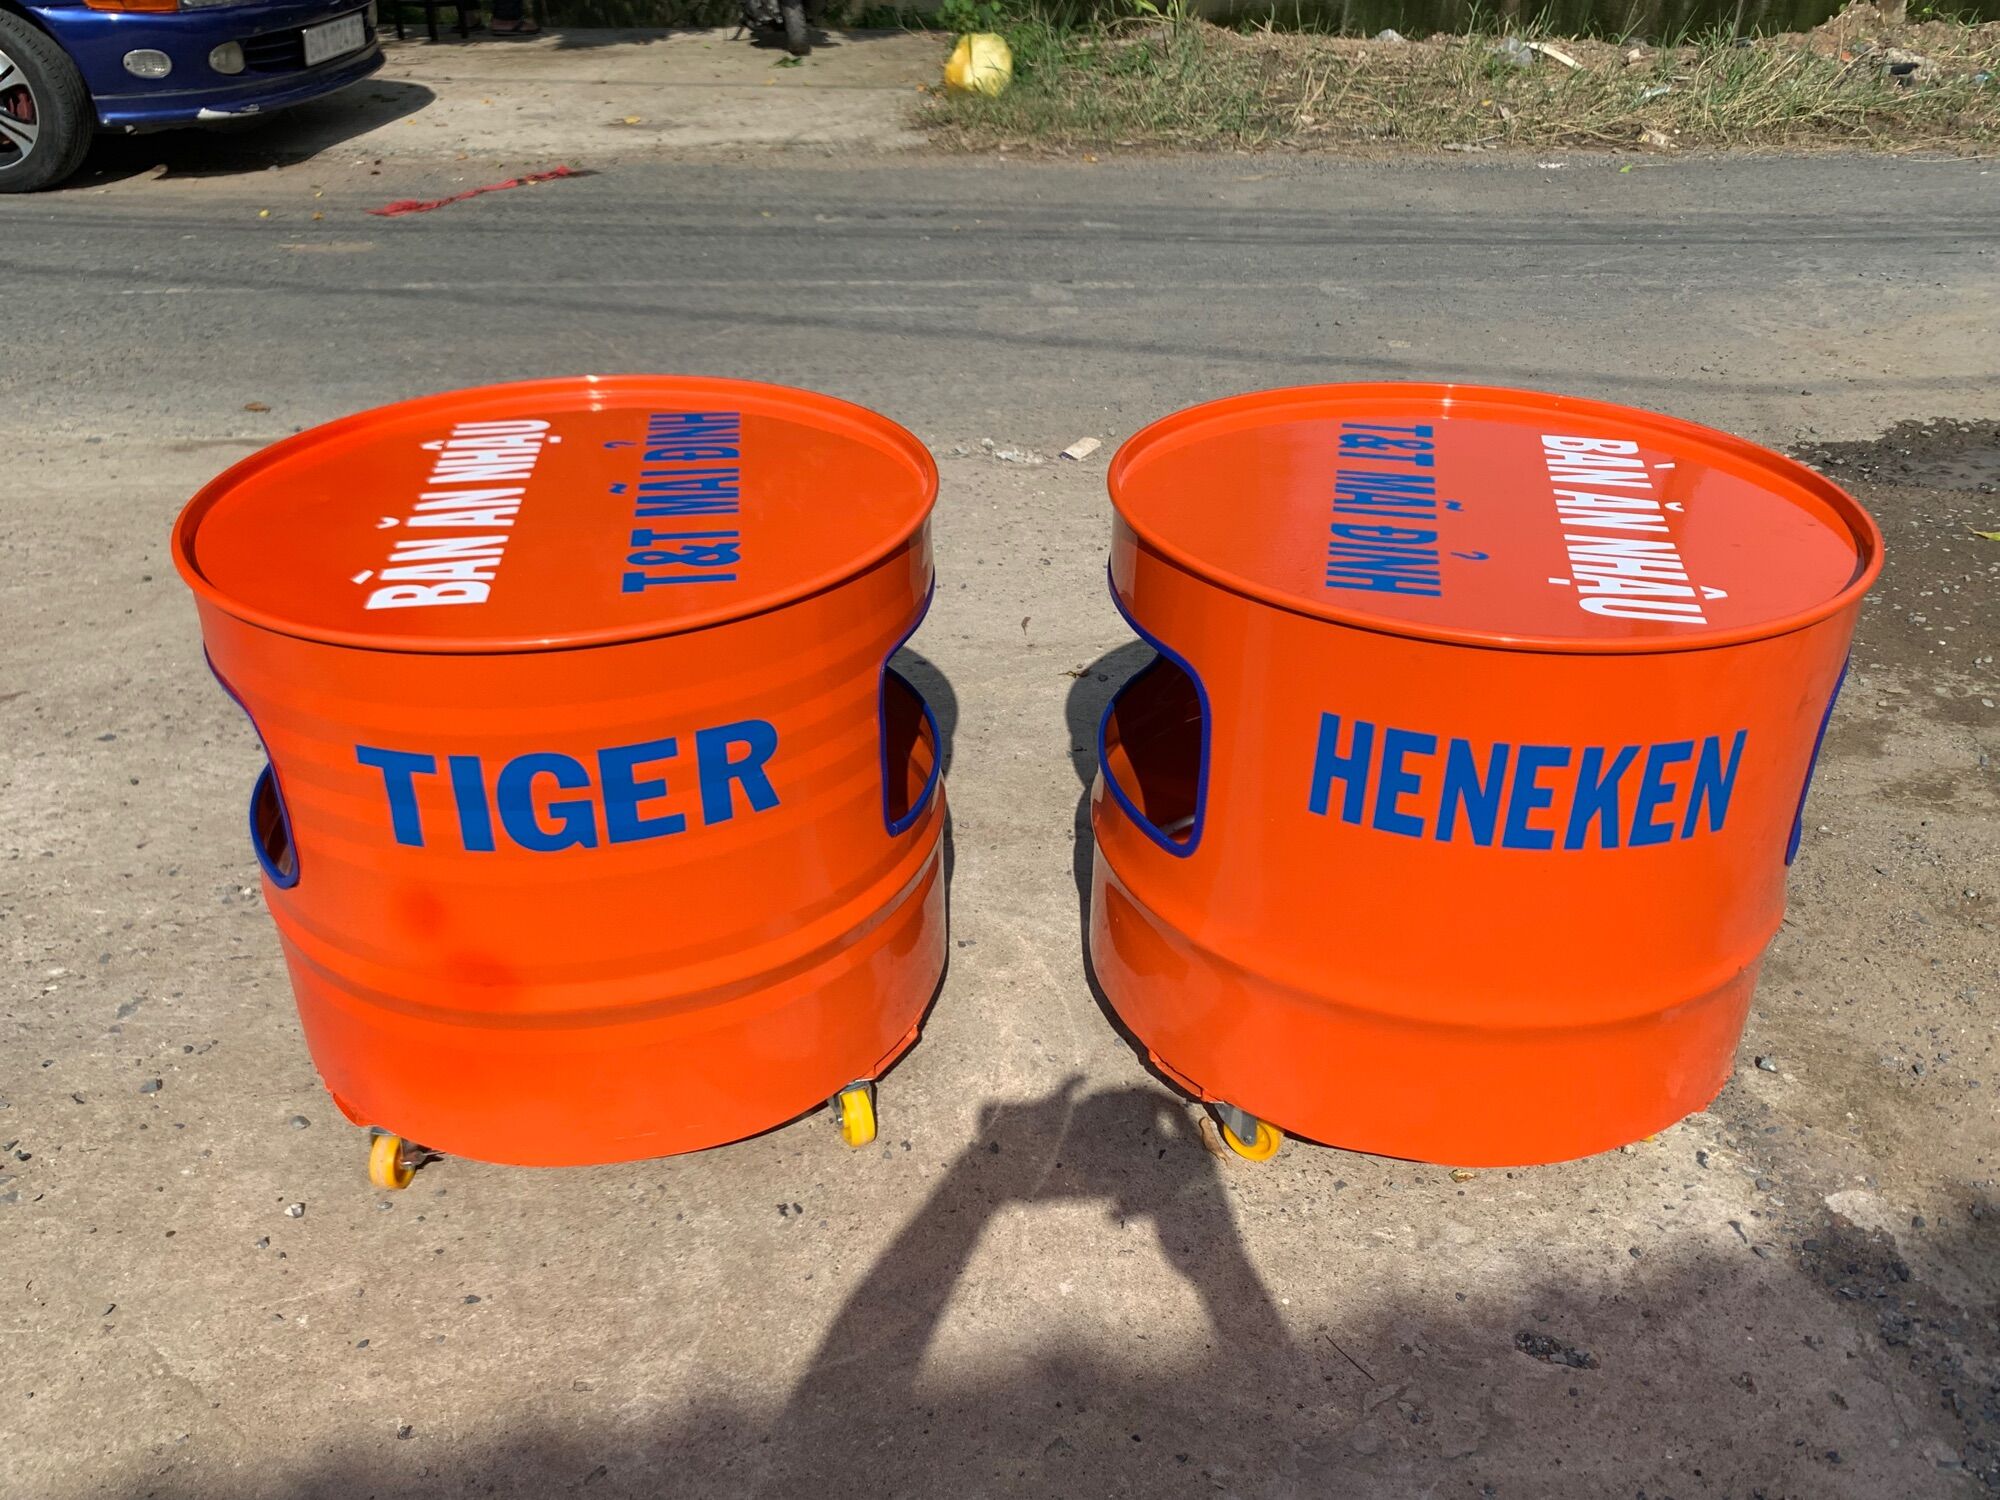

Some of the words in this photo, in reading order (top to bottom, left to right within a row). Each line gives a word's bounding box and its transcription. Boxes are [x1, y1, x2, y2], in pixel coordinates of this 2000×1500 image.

[419, 419, 561, 486] NHẬU
[603, 412, 740, 462] ĐỈNH
[1339, 422, 1436, 467] T&T
[1541, 434, 1676, 488] BÀN
[375, 487, 526, 529] ĂN
[609, 468, 740, 517] MÃI
[1332, 469, 1464, 519] MÃI
[1552, 489, 1684, 532] ĂN
[351, 535, 509, 610] BÀN
[622, 528, 741, 593] T&T
[1326, 523, 1489, 598] ĐỈNH
[1548, 534, 1728, 625] NHẬU
[356, 719, 780, 852] TIGER
[1309, 712, 1748, 850] HENEKEN
